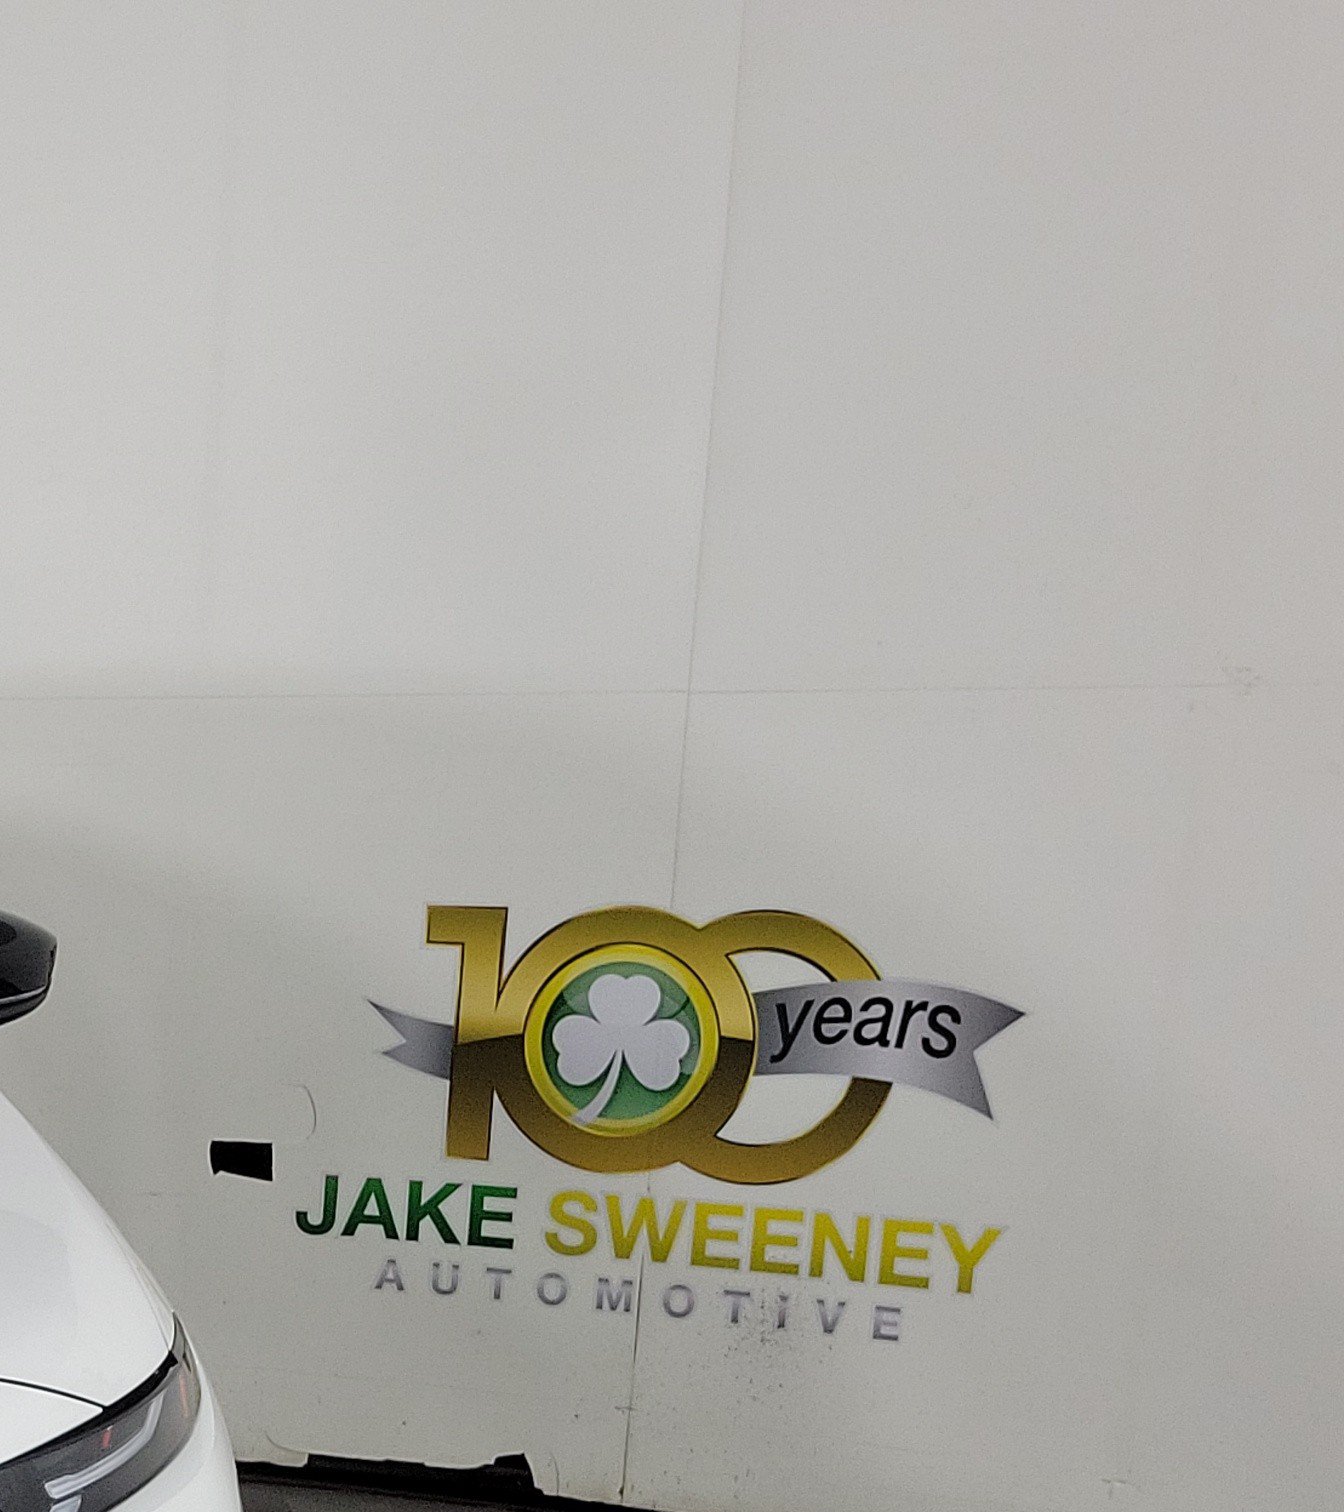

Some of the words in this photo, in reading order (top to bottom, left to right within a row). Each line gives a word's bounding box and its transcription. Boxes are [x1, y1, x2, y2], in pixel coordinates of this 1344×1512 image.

[426, 905, 896, 1184] 100
[770, 995, 962, 1062] years
[296, 1174, 518, 1250] JAKE
[544, 1190, 1002, 1295] SWEENEY
[375, 1258, 902, 1342] AUTOMOTIVE
